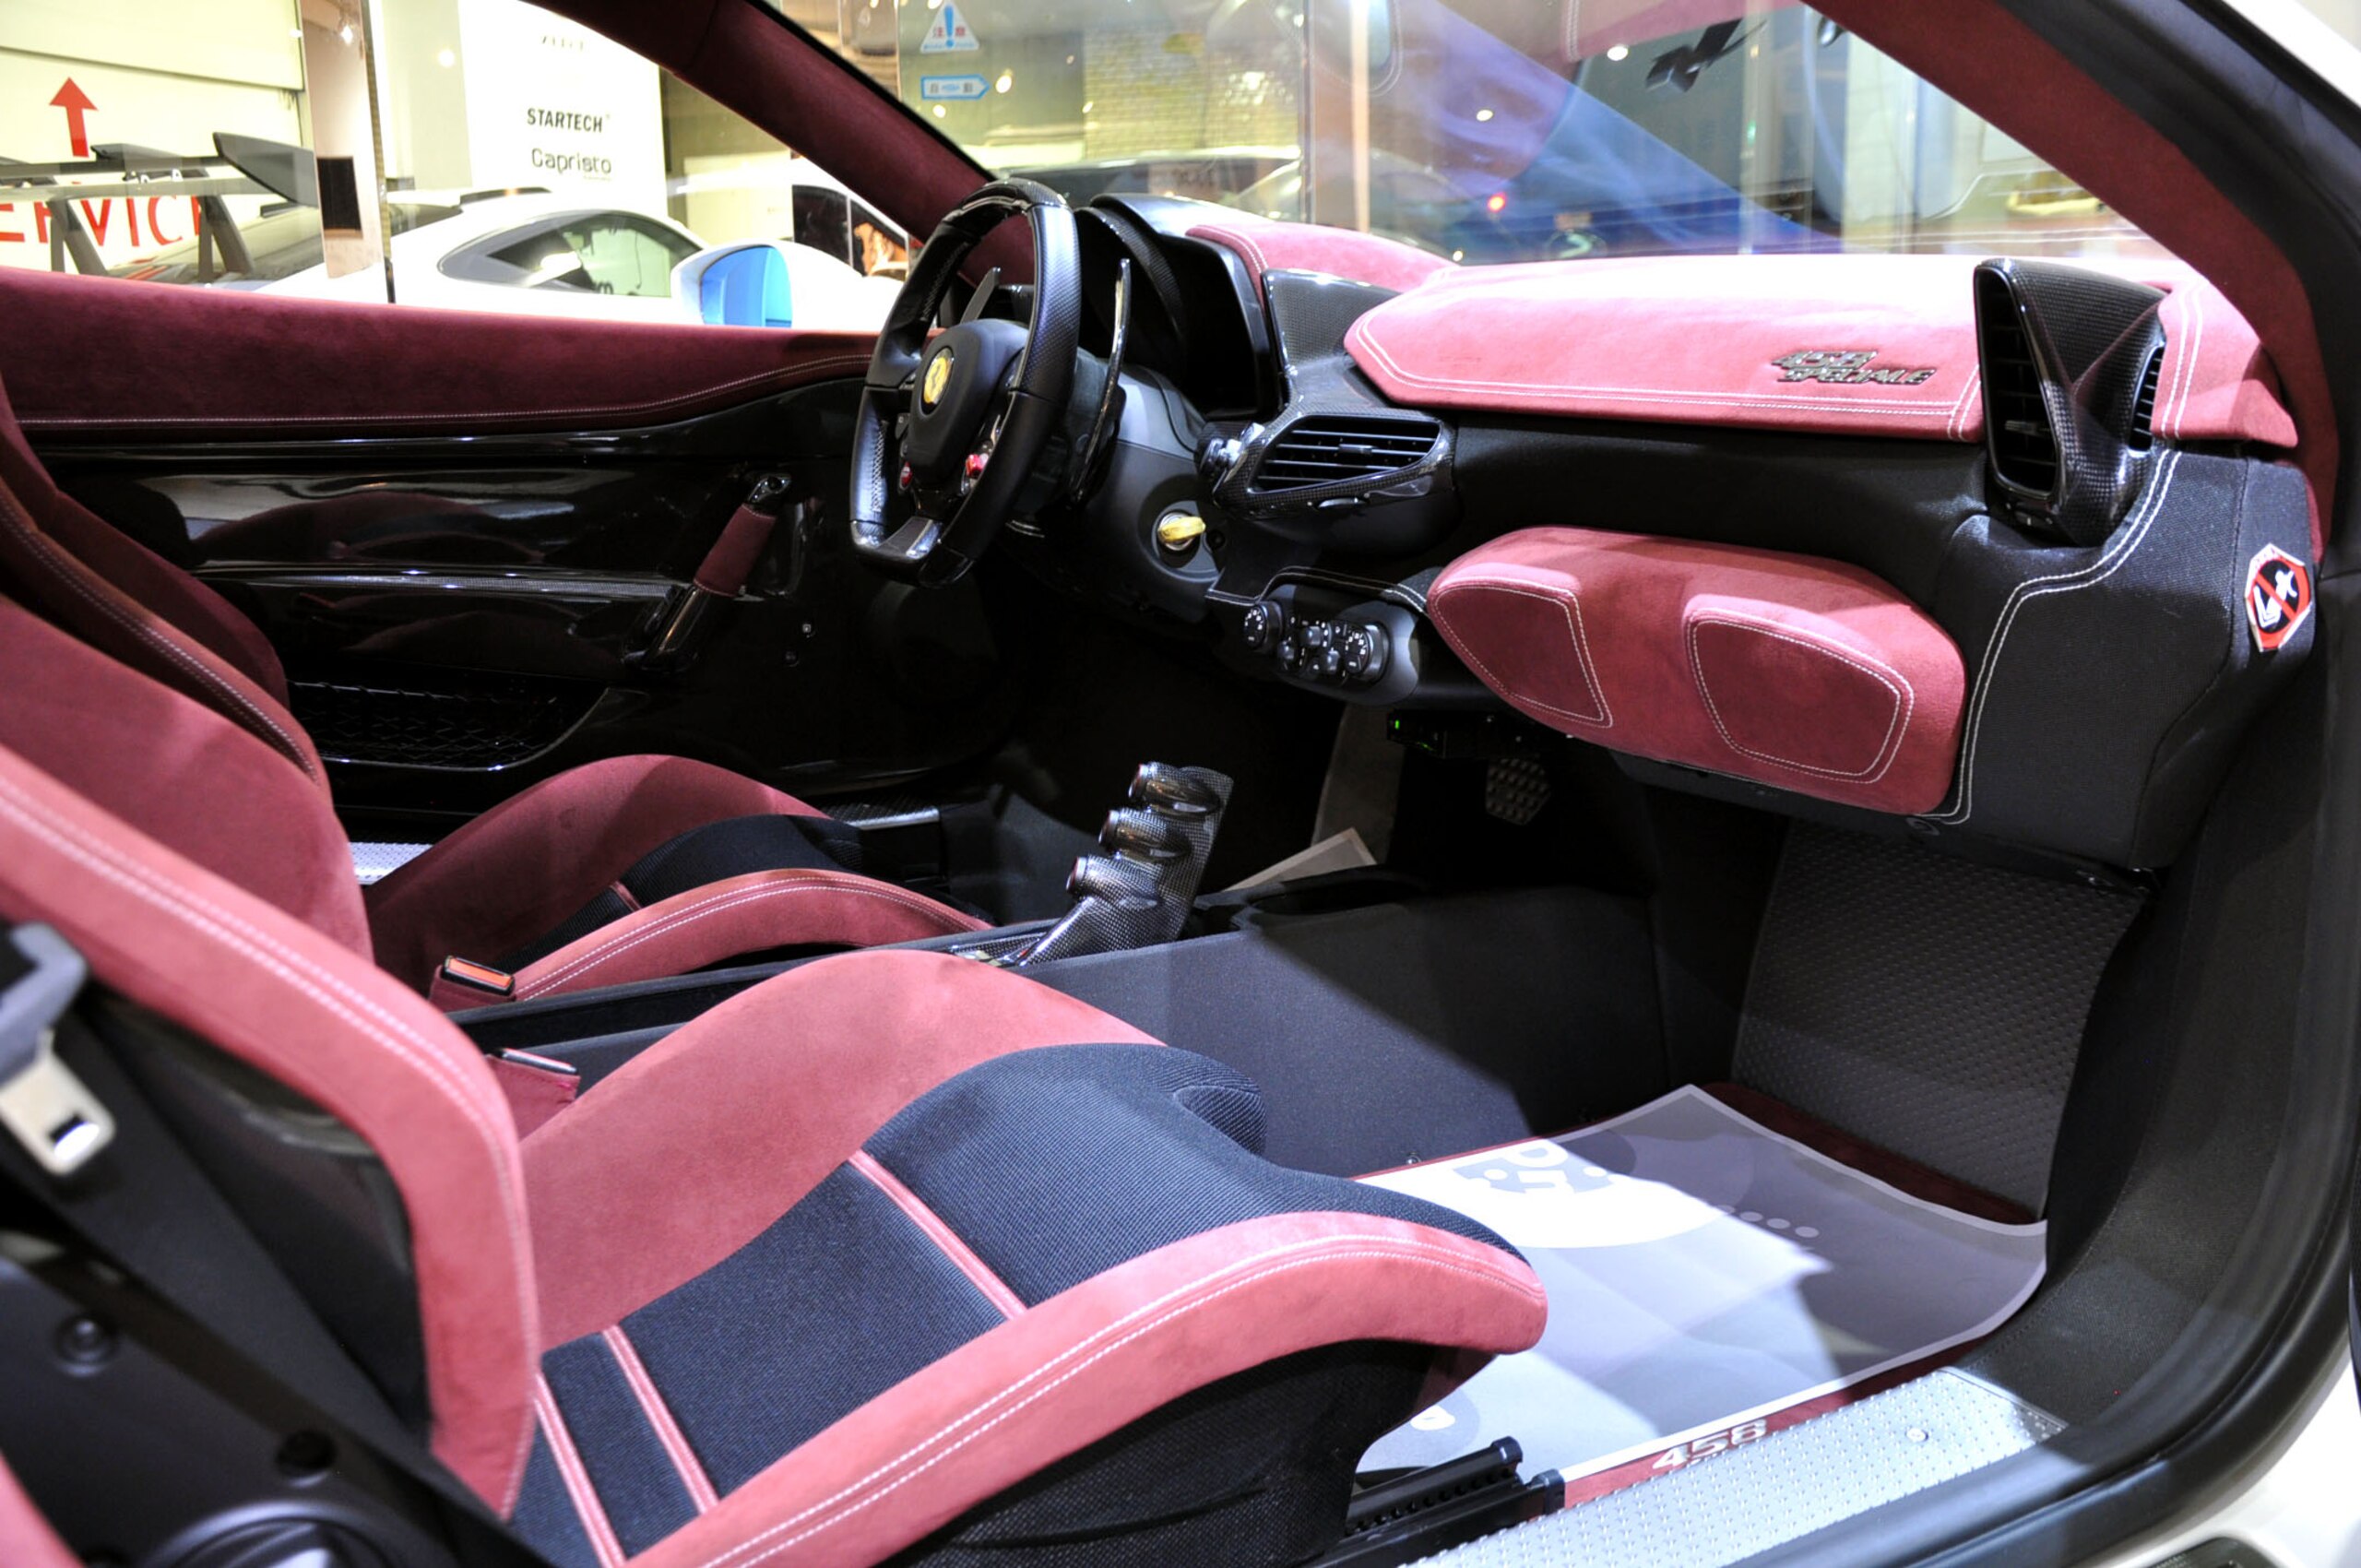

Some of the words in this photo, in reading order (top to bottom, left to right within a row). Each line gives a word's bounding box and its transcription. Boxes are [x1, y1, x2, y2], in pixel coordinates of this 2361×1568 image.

[527, 107, 603, 133] STARTECH
[531, 148, 612, 174] Capristo
[1652, 1419, 1767, 1470] 458
